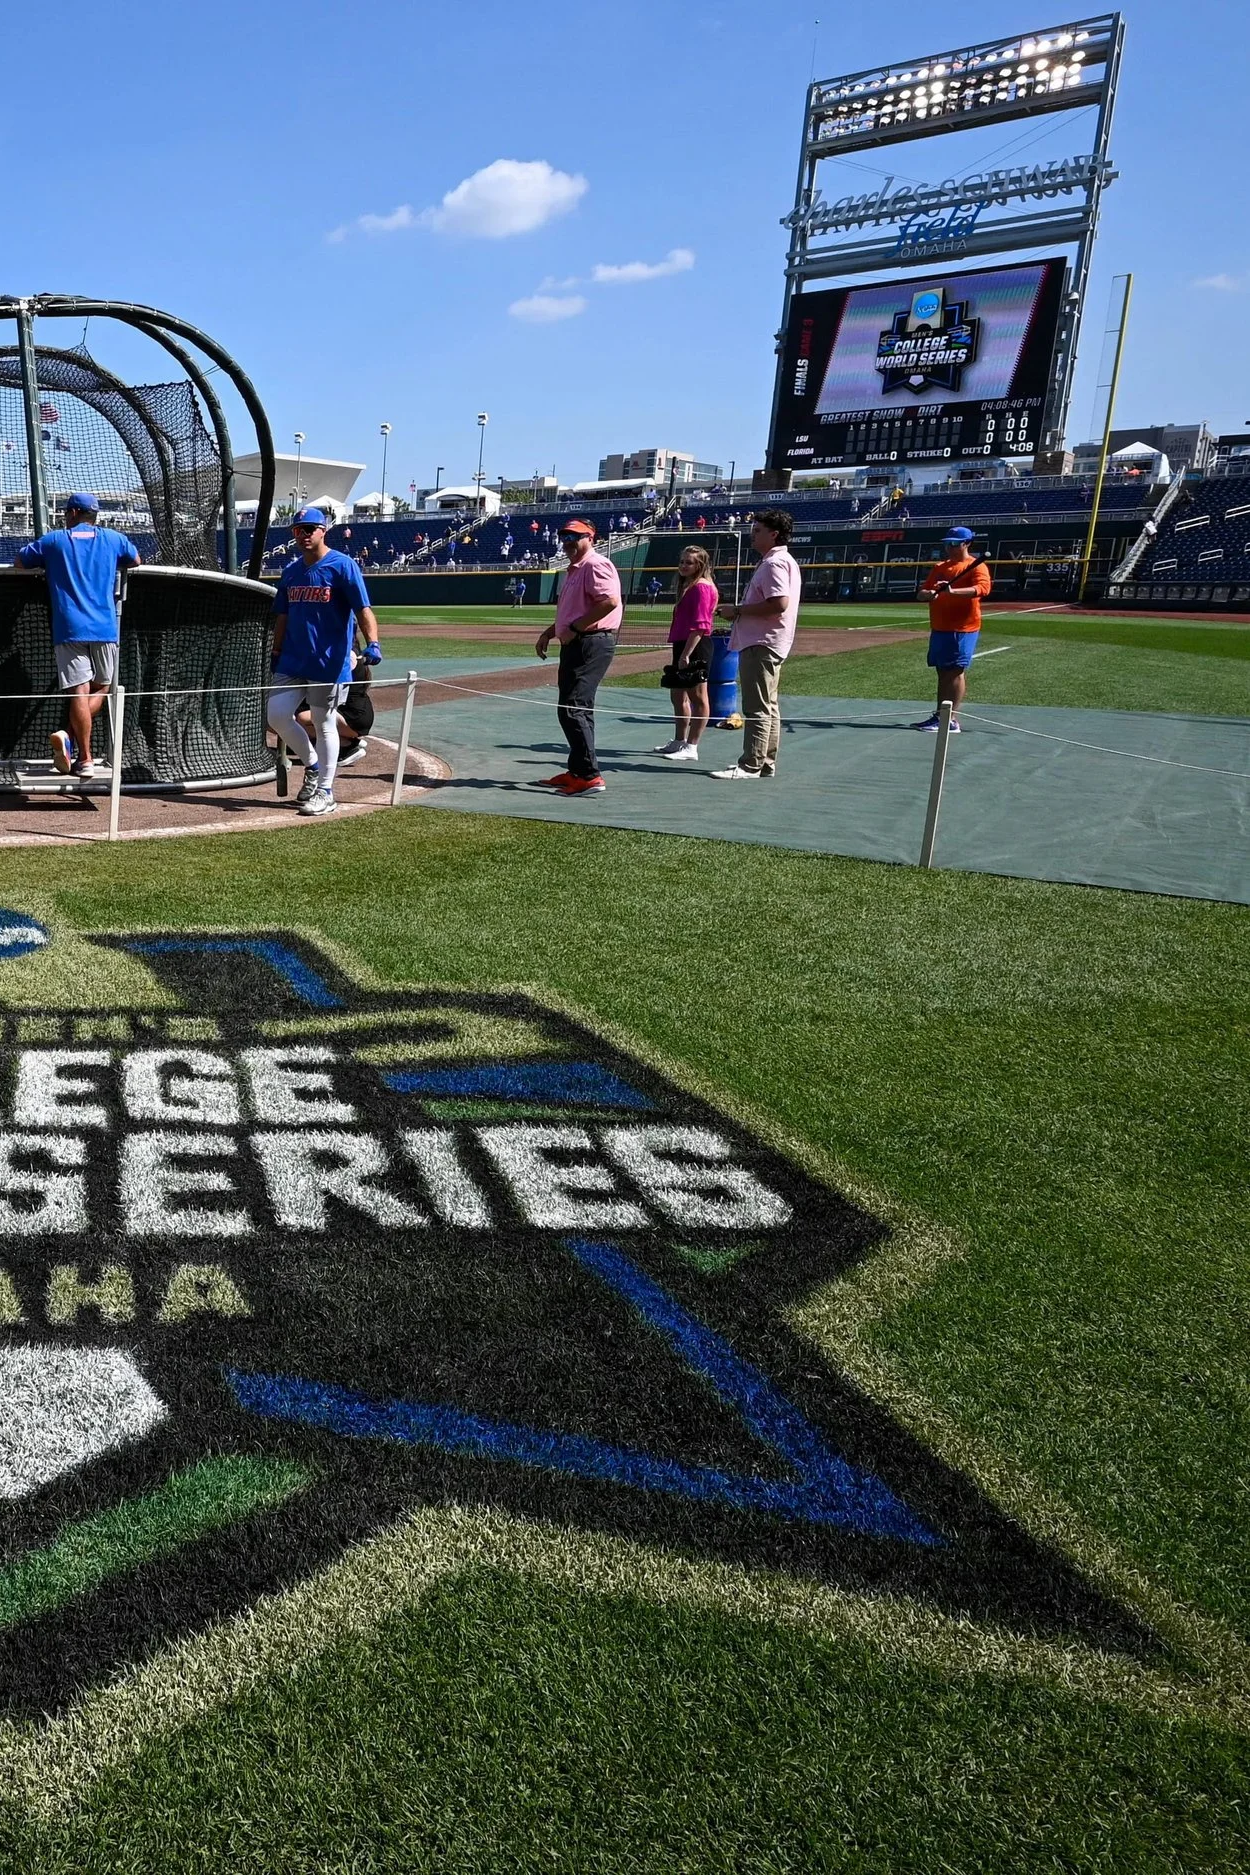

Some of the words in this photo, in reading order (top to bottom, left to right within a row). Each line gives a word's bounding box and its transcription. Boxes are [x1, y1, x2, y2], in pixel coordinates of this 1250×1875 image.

[938, 154, 1103, 204] SCHWAB
[901, 239, 968, 259] OMAHA
[893, 336, 950, 354] COLLEGE
[875, 353, 918, 370] WORLD
[918, 348, 968, 366] SERIES
[793, 358, 809, 396] FINALS
[1025, 397, 1041, 408] PM
[820, 411, 871, 425] GREATEST
[871, 407, 905, 421] SHOW
[917, 404, 944, 417] DIRT
[795, 435, 809, 443] LSU
[787, 447, 815, 456] FLORIDA
[961, 446, 983, 455] OUT
[1009, 441, 1034, 453] 4:08
[865, 453, 890, 461] BALL
[906, 449, 944, 458] STRIKE
[825, 456, 844, 464] BAT
[861, 530, 905, 542] ESPN
[1046, 562, 1069, 573] 335
[287, 585, 332, 603] ATORS
